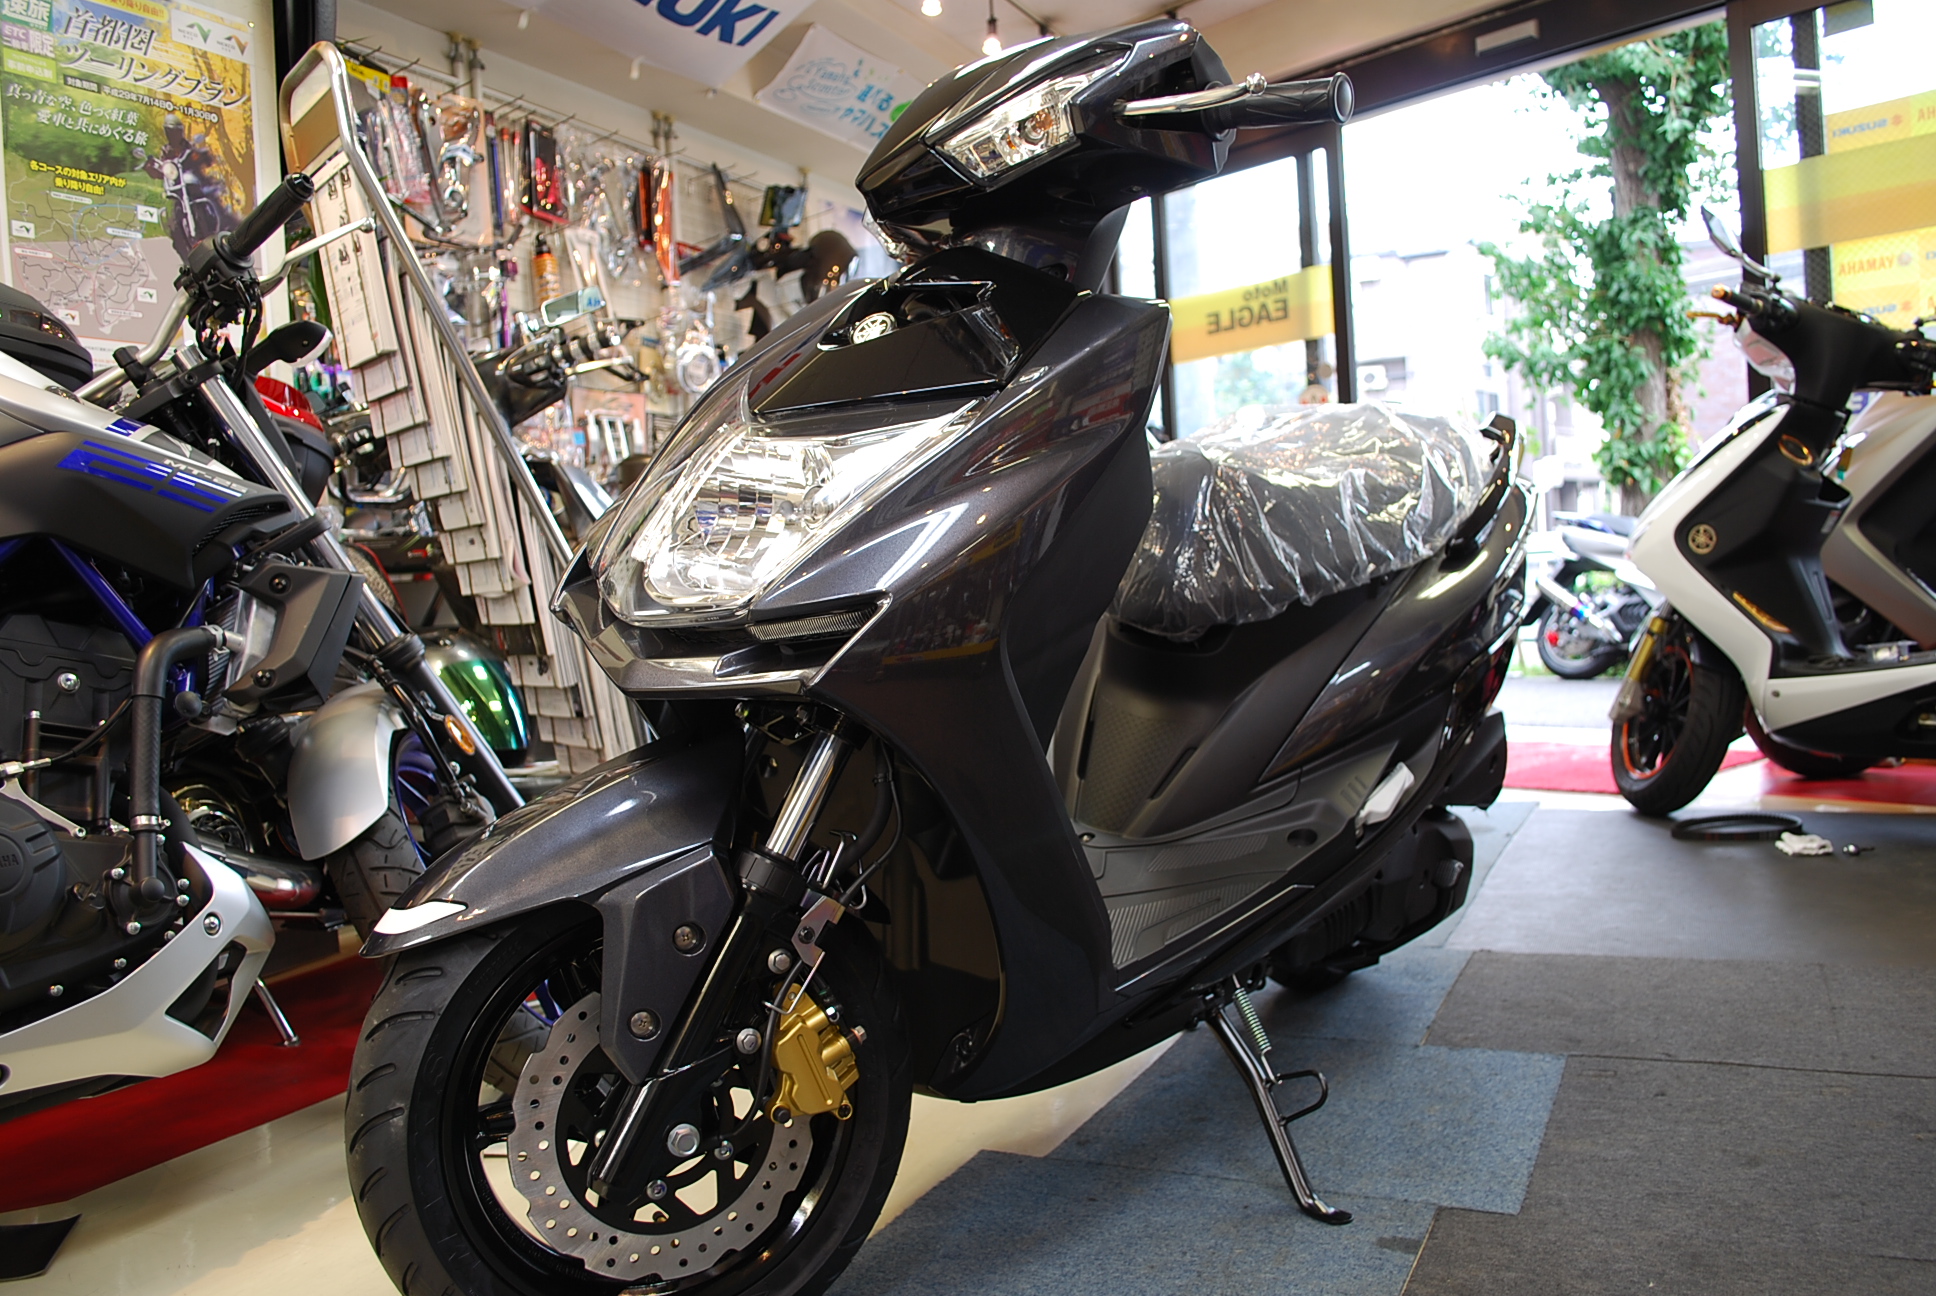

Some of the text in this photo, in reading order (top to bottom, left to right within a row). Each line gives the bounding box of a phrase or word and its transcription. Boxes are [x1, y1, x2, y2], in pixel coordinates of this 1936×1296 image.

[62, 6, 156, 57] 首都圏
[60, 45, 250, 108] ツーリングプラン
[37, 108, 149, 147] 愛車と共にめぐる旅
